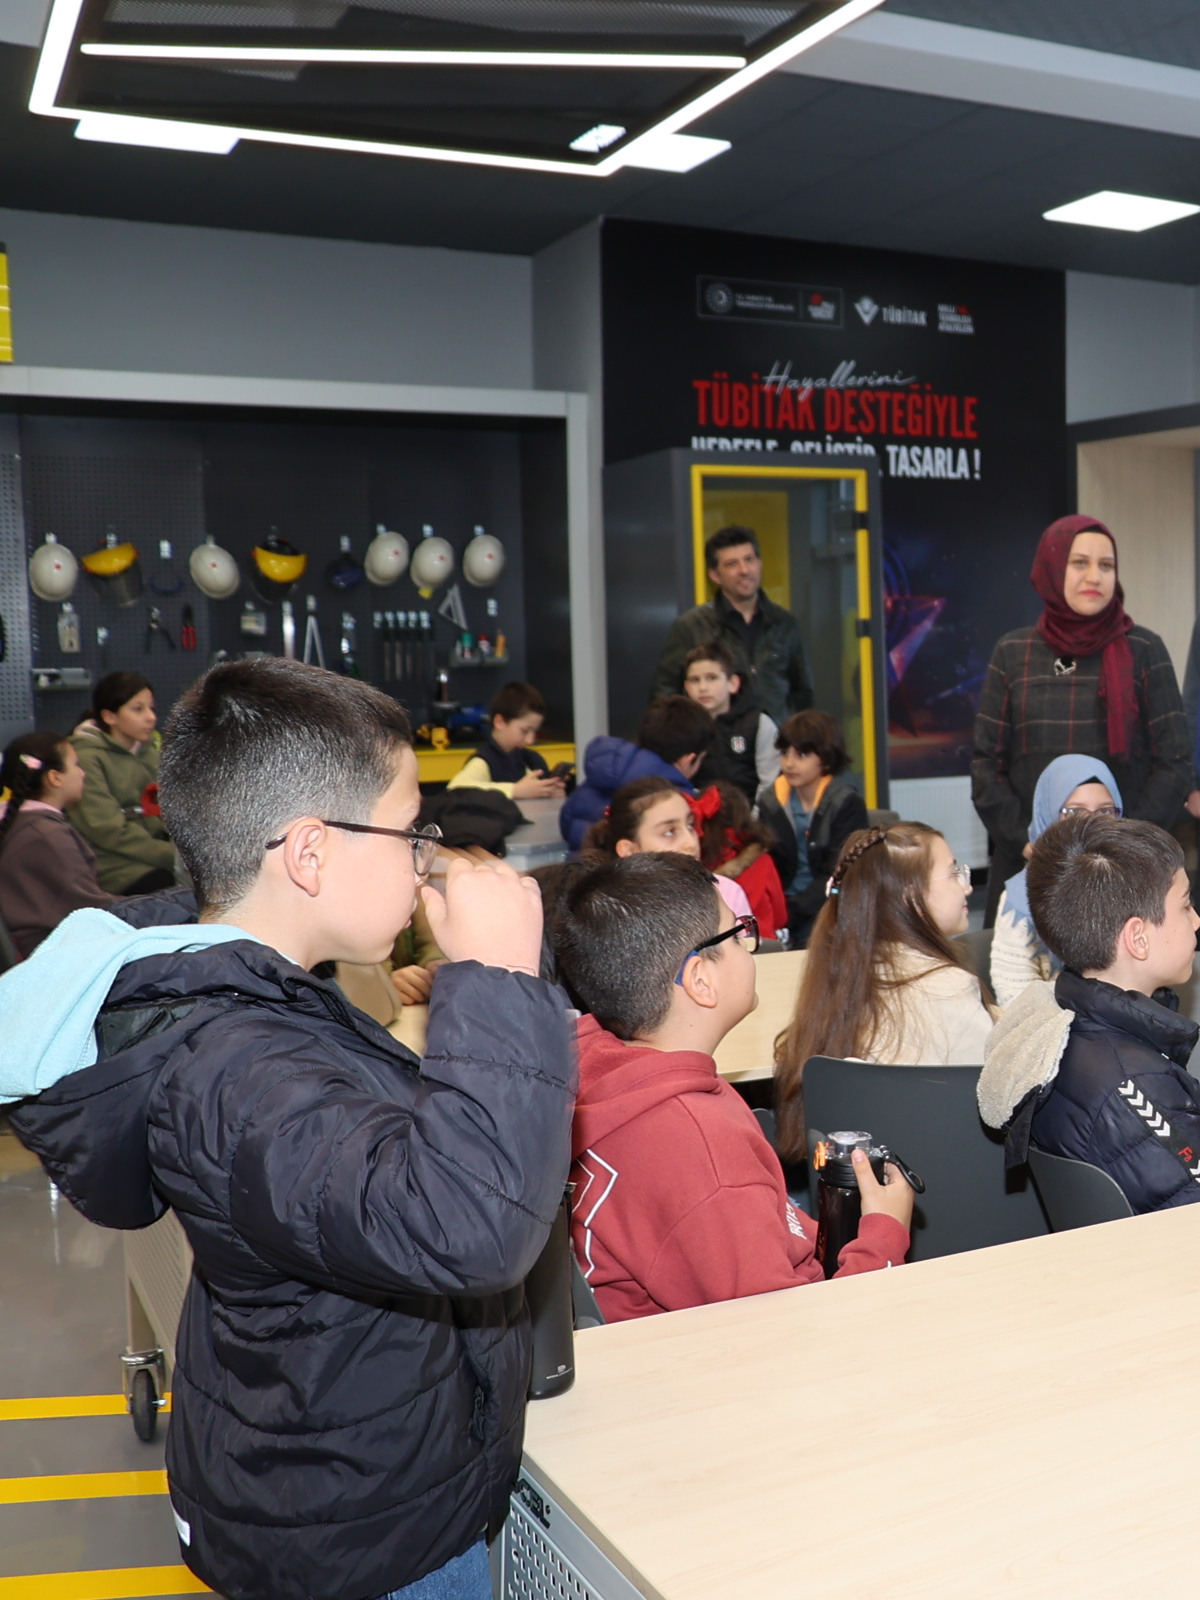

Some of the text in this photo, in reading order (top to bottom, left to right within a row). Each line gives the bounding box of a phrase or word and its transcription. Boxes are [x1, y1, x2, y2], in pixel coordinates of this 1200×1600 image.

[882, 305, 928, 326] TÜBİTAK
[692, 371, 979, 439] TÜBİTAK DESTEĞİYLE
[886, 444, 970, 479] TASARLA
